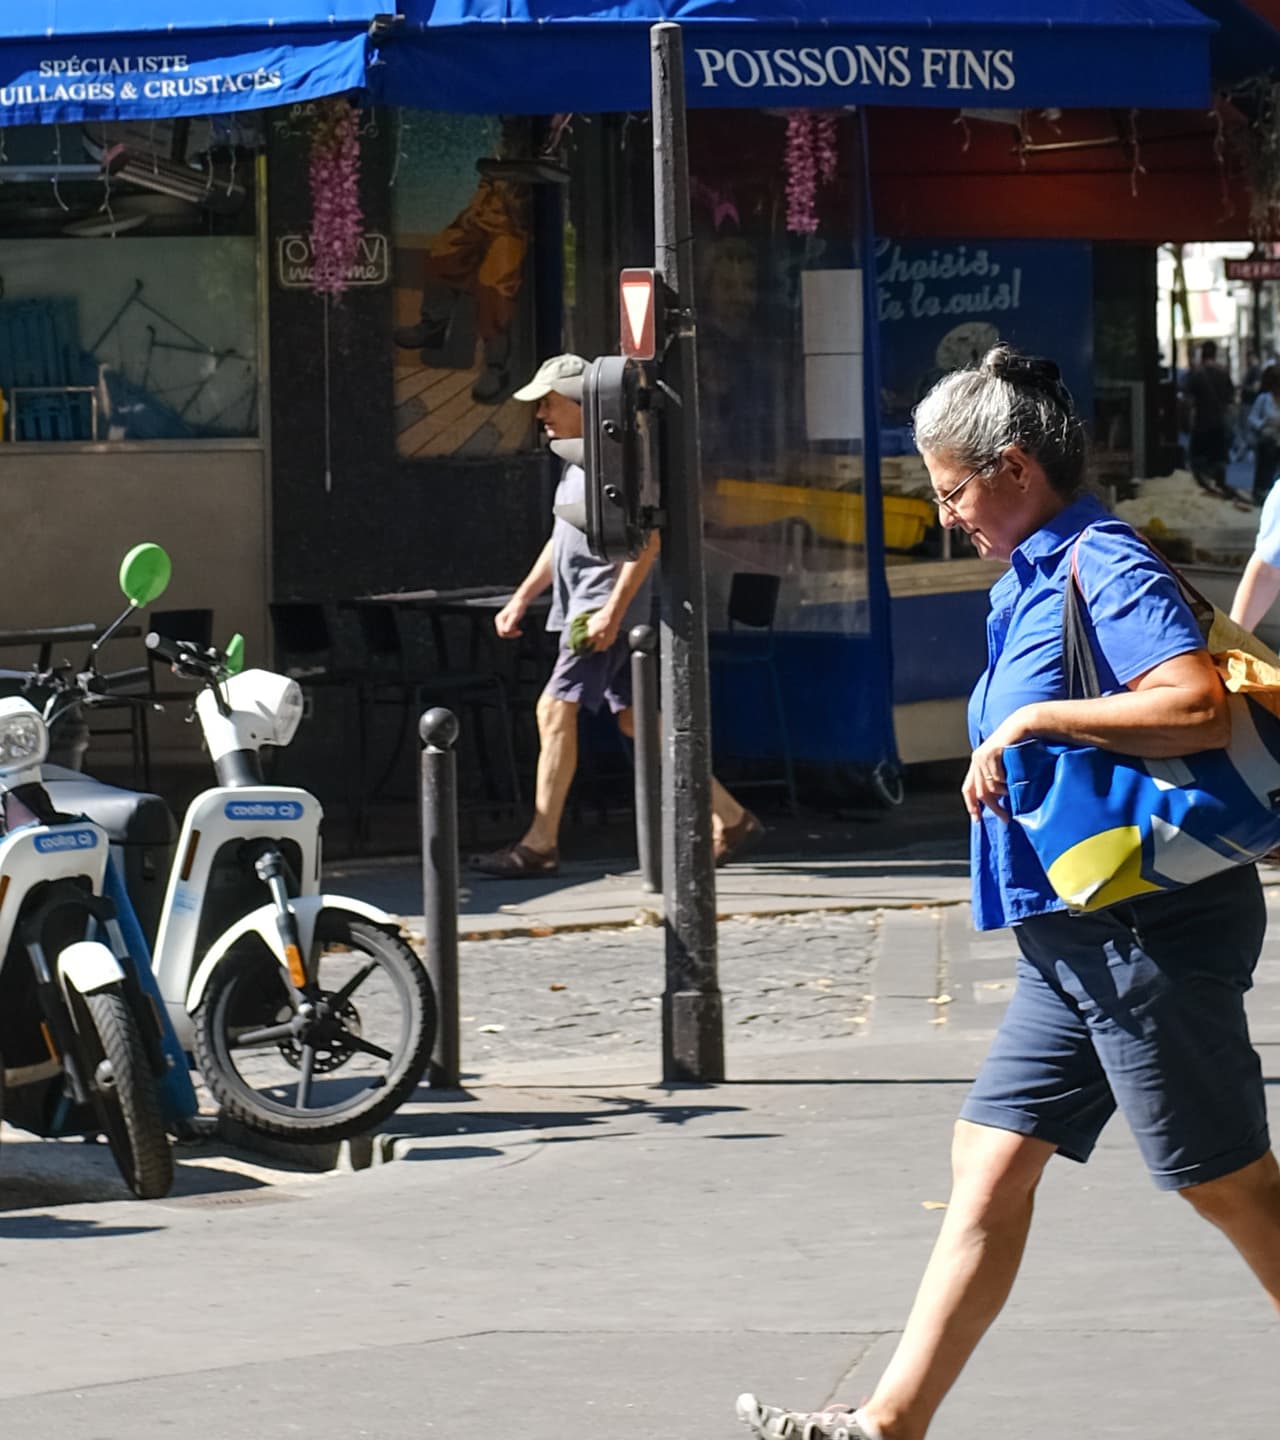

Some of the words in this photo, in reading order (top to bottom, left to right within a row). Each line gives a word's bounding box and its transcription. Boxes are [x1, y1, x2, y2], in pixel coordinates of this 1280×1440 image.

[39, 54, 189, 78] SPÉCIALISTE
[694, 44, 913, 89] POISSONS
[921, 47, 1016, 91] FINS
[120, 80, 138, 100] &
[143, 67, 282, 98] CRUSTACÉS
